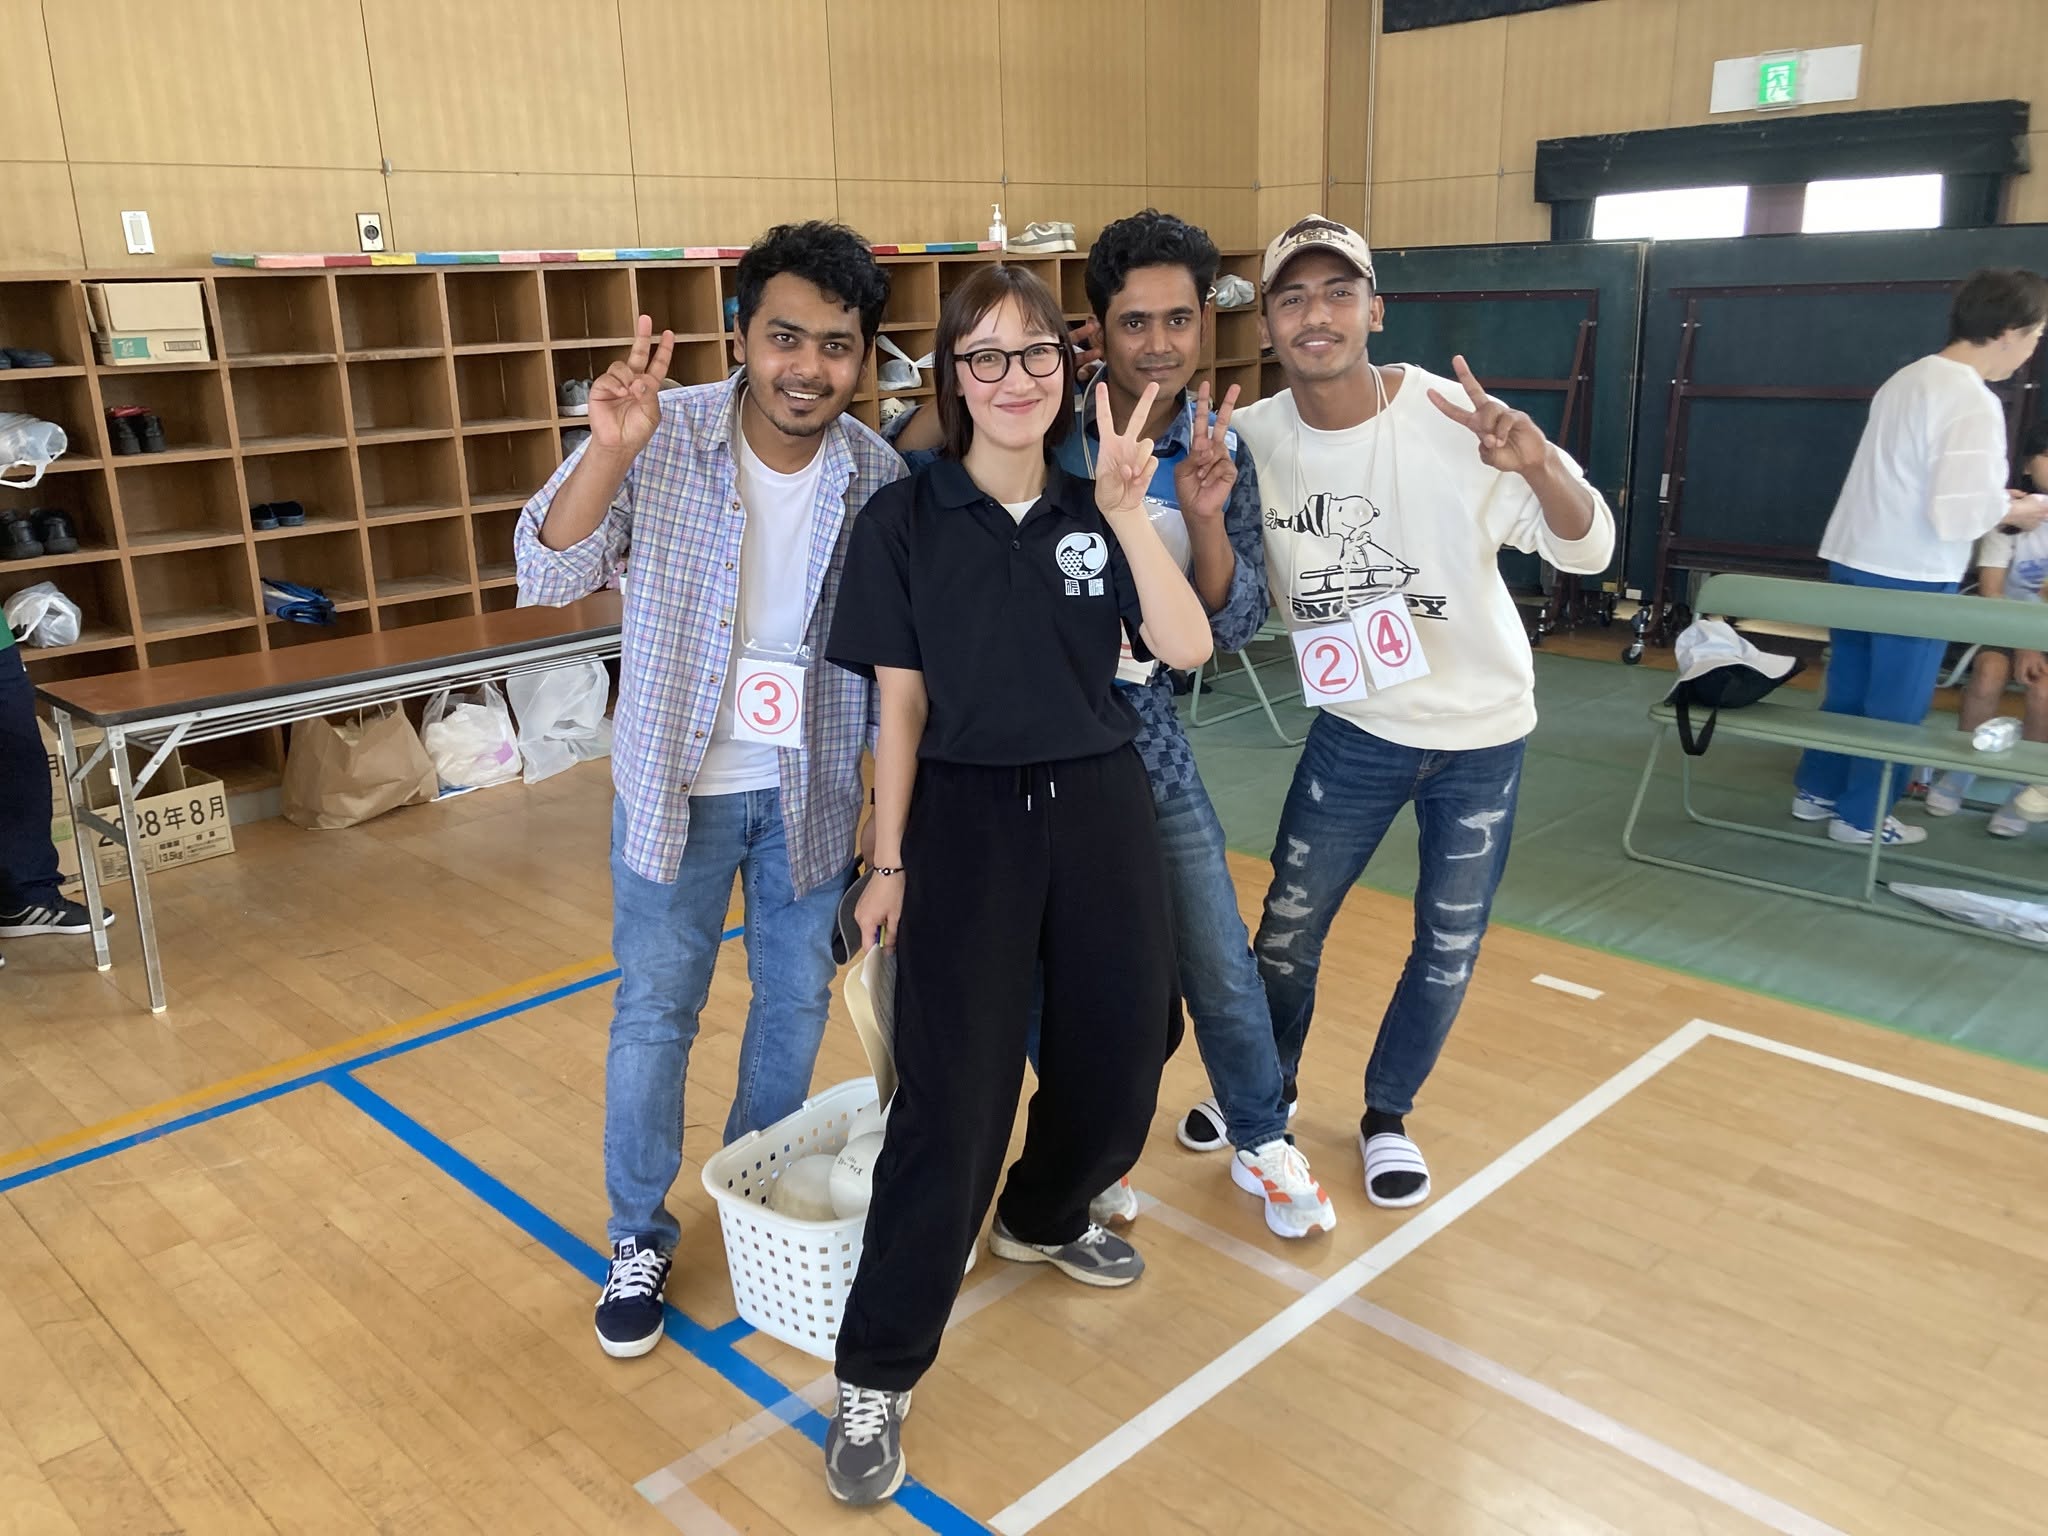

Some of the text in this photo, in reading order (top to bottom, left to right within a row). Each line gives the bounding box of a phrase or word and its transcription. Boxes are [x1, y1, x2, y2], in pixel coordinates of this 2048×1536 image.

[1292, 598, 1447, 618] SNPY
[1376, 614, 1404, 659] 4
[1315, 643, 1348, 687] 2
[752, 680, 782, 726] 3
